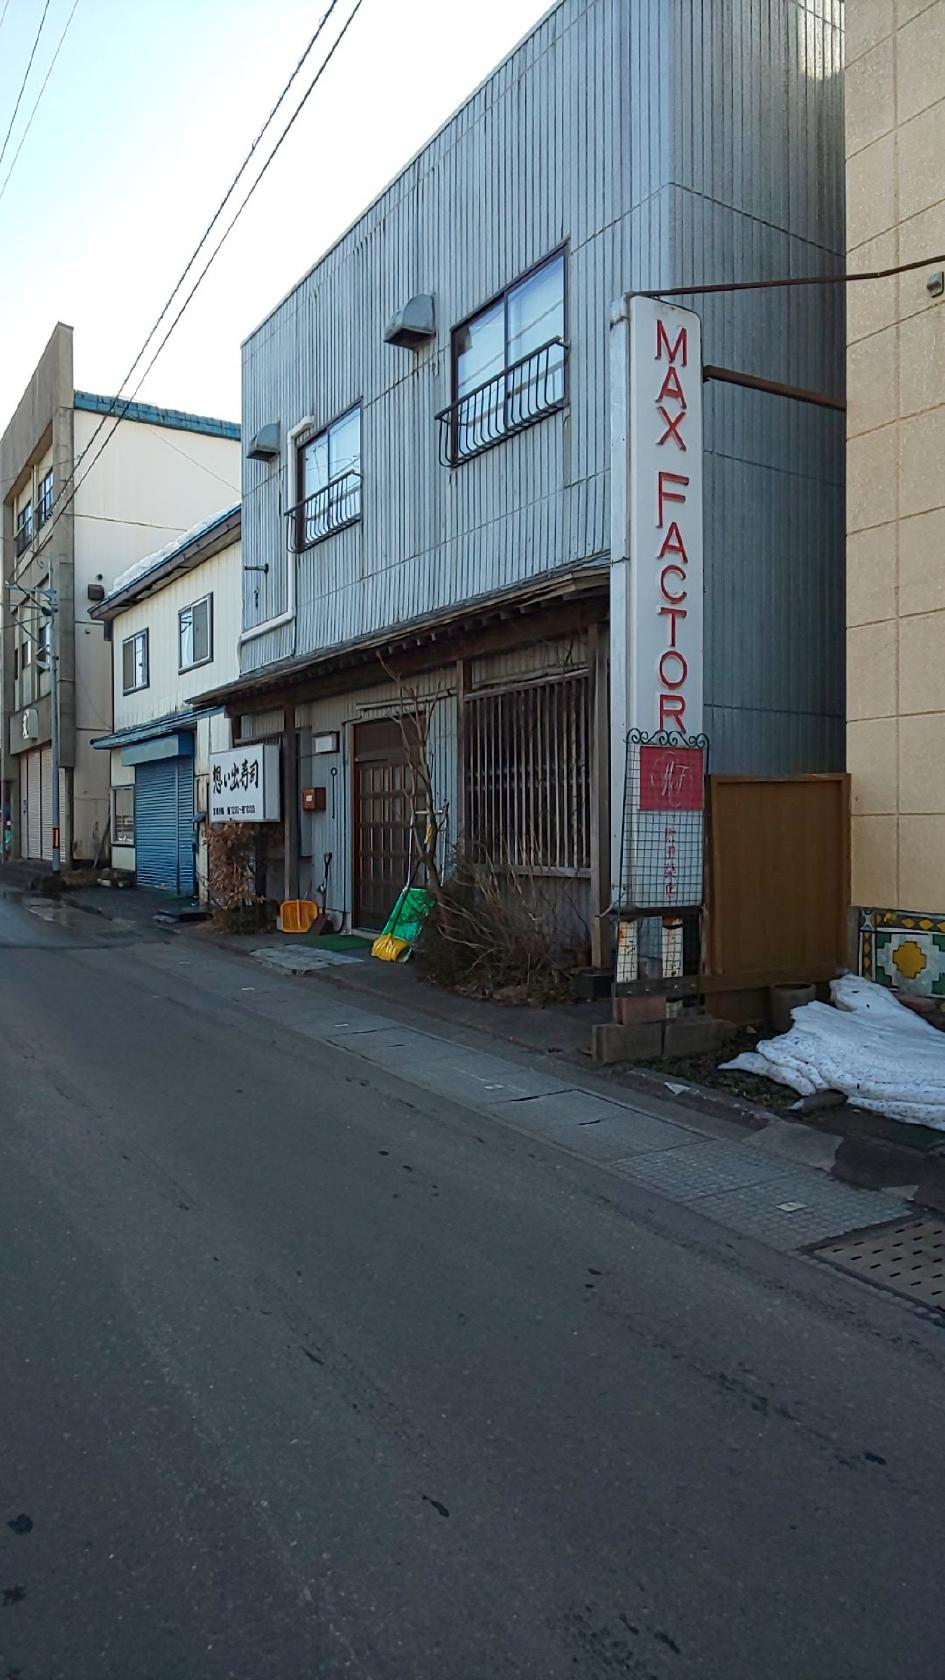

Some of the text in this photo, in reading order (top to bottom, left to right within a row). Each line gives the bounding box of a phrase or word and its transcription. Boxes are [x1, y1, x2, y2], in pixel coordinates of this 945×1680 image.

[655, 319, 690, 734] MAX FACTOR
[212, 758, 259, 795] 想い出寿司
